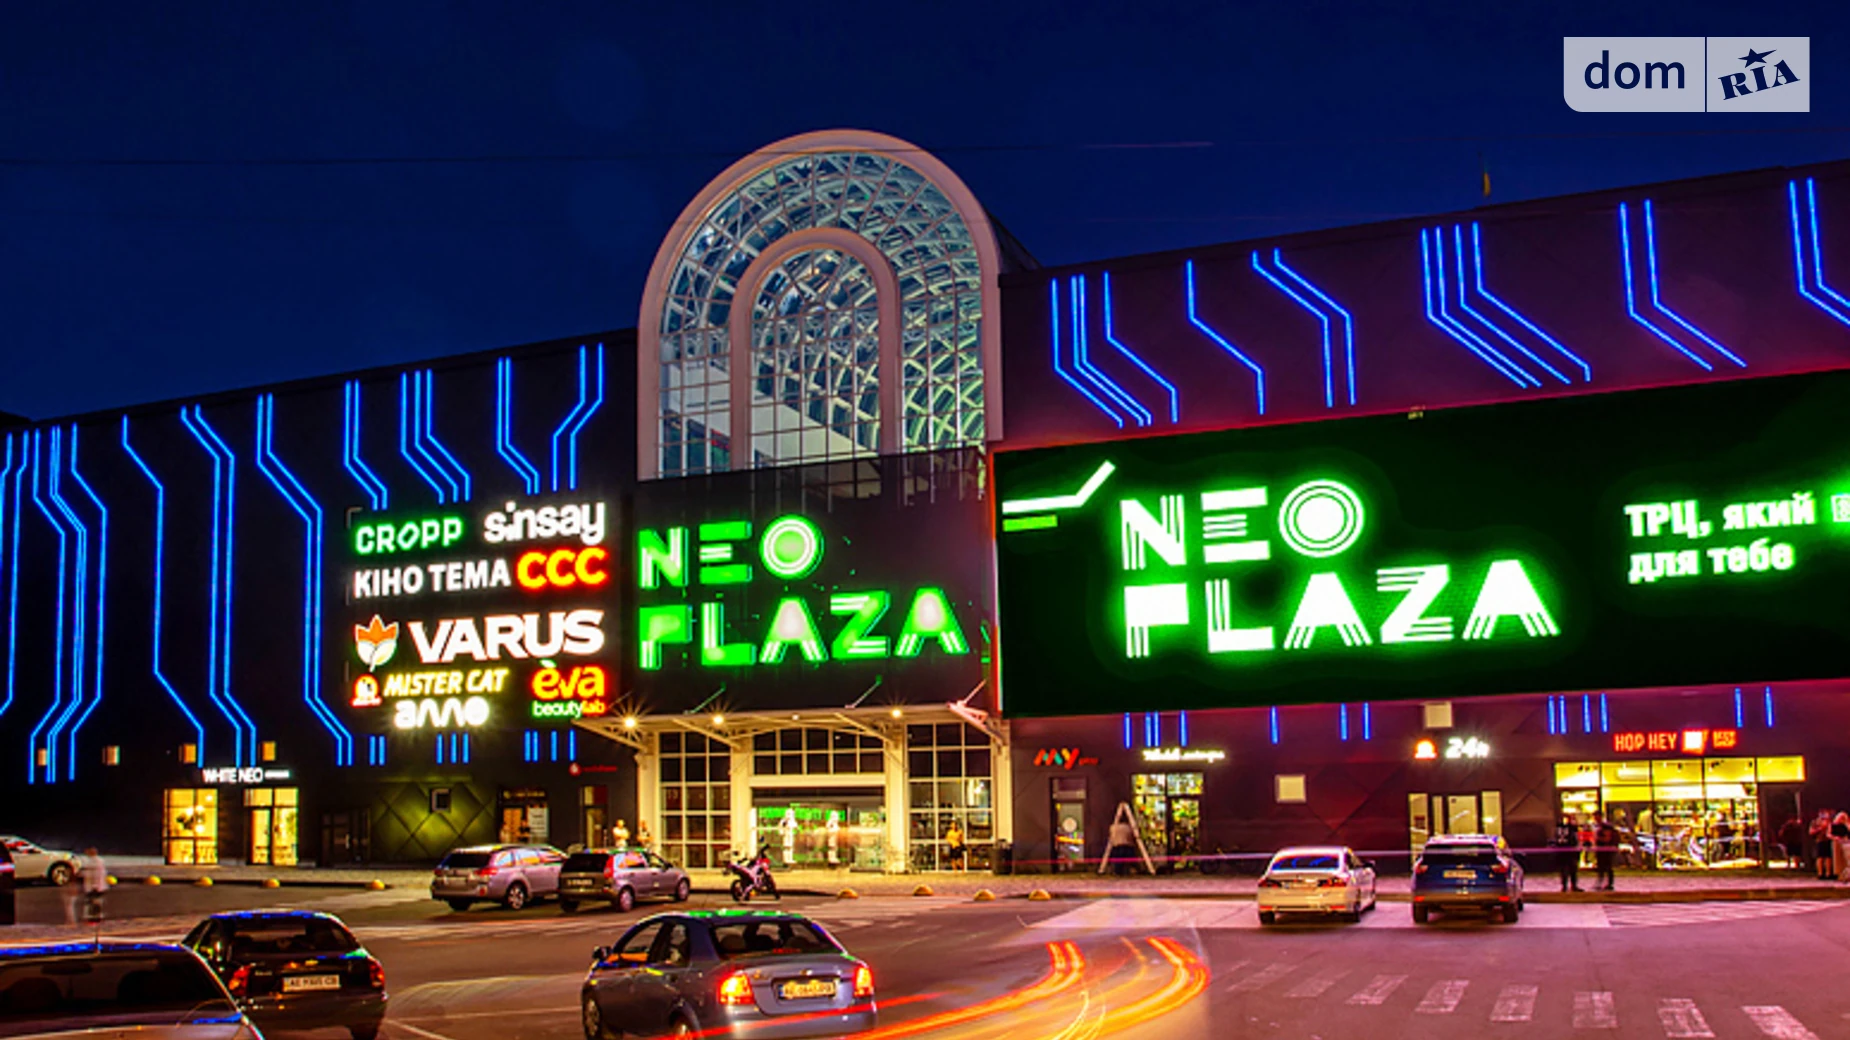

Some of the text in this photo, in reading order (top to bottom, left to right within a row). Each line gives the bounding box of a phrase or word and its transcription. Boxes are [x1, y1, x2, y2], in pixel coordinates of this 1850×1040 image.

[356, 516, 463, 555] CROPP
[483, 501, 606, 546] sinsay
[1119, 479, 1365, 571] NEO
[1624, 499, 1713, 539] ТРЦ,
[1722, 490, 1816, 531] який
[516, 547, 608, 590] CCC
[638, 514, 825, 589] NEO
[1628, 537, 1796, 585] для тебе
[638, 587, 971, 671] PLAZA
[1124, 558, 1561, 659] PLAZA
[407, 609, 606, 664] VARUS
[383, 667, 510, 698] MISTER CAT
[1614, 731, 1678, 752] HOP HEY
[238, 766, 263, 784] NEO
